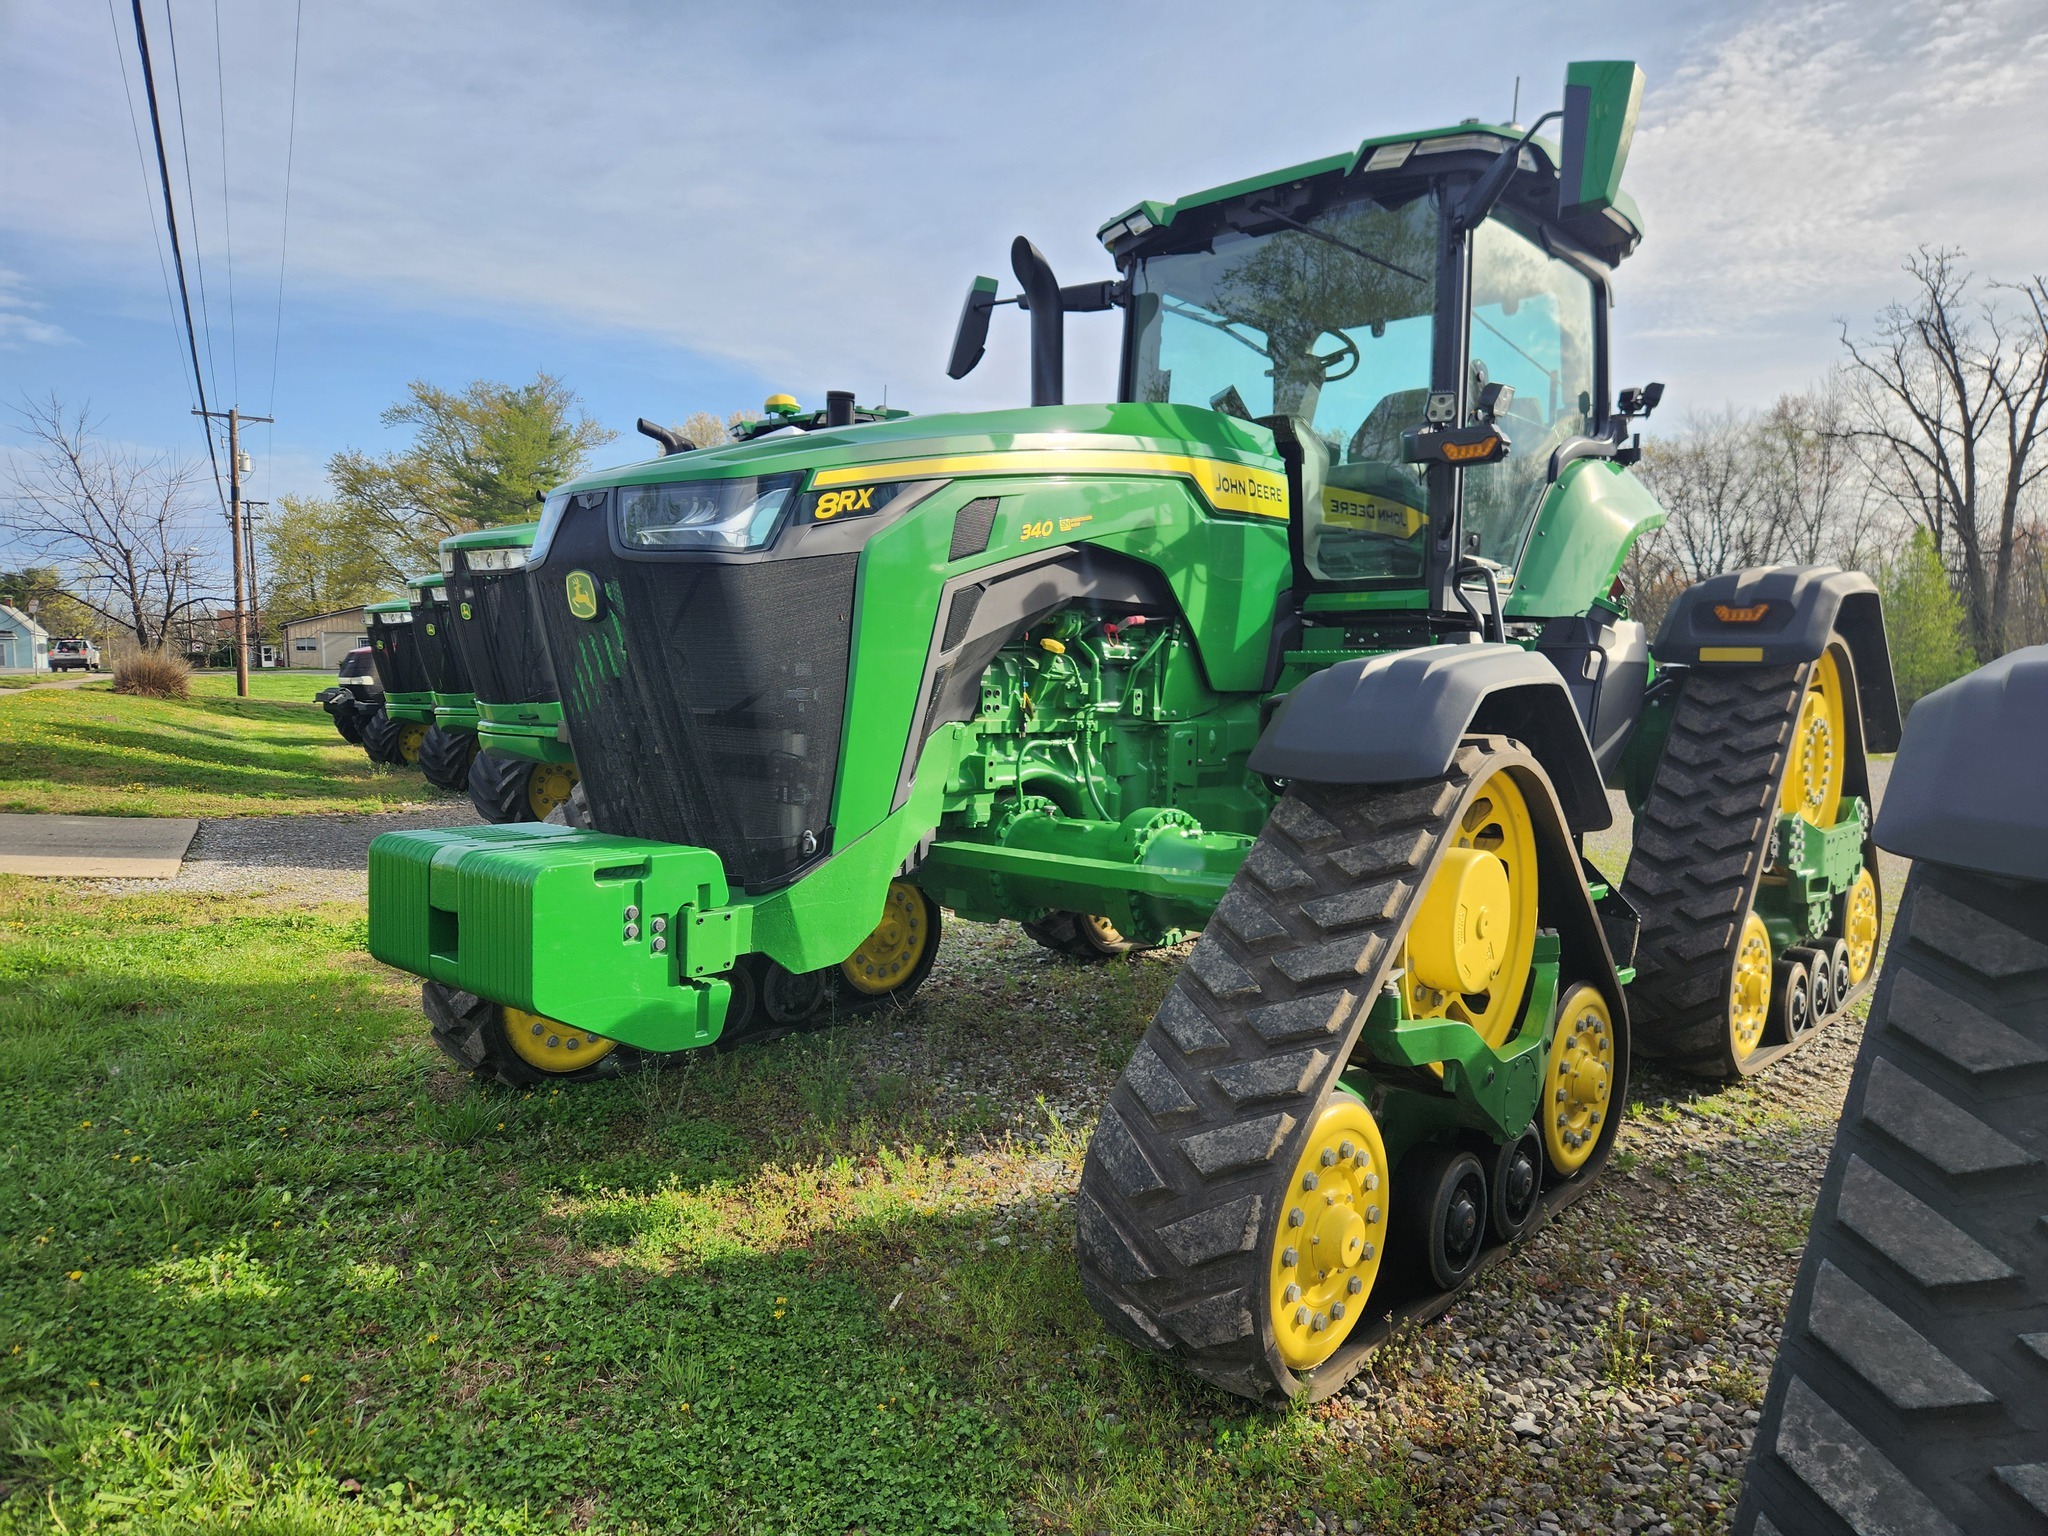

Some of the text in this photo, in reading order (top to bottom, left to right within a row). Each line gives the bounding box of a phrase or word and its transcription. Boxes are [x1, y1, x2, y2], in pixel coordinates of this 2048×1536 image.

[1215, 473, 1283, 502] JOHN DEERE
[815, 488, 875, 519] 8RX
[1020, 520, 1054, 541] 340
